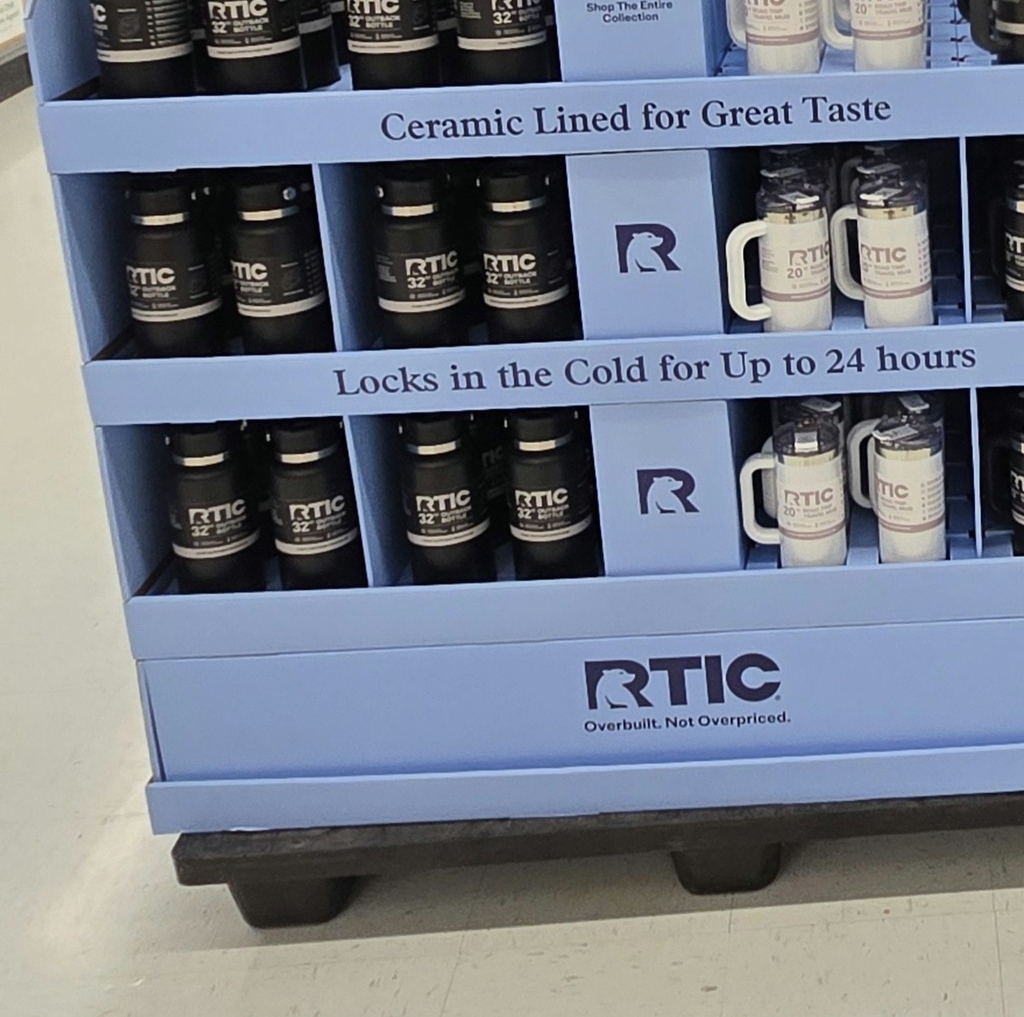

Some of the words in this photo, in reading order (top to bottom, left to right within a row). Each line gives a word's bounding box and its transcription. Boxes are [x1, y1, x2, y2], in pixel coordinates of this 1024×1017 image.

[586, 2, 614, 13] Shop
[616, 1, 638, 11] The
[640, 0, 673, 10] Entire
[602, 12, 659, 23] Collection
[380, 108, 523, 141] Ceramic
[533, 104, 630, 135] Lined
[642, 102, 691, 131] for
[701, 99, 793, 129] Great
[801, 95, 892, 124] Taste
[615, 223, 681, 273] R
[405, 250, 458, 276] RTIC
[483, 253, 536, 272] RTIC
[333, 367, 439, 395] Locks
[450, 364, 487, 390] in
[497, 362, 553, 388] the
[564, 356, 648, 386] Cold
[659, 354, 710, 382] for
[720, 351, 771, 384] Up
[783, 352, 816, 376] to
[825, 348, 866, 373] 24
[876, 345, 977, 373] hours
[416, 489, 471, 512] RTIC
[515, 487, 568, 508] RTIC
[636, 468, 700, 514] R
[784, 488, 833, 506] RTIC
[879, 480, 909, 499] TIC
[188, 499, 246, 525] RTIC
[289, 495, 345, 521] RTIC
[584, 653, 781, 710] RTIC
[584, 717, 662, 732] Overbuilt.
[665, 716, 694, 729] Not
[698, 711, 791, 728] Overpriced.
